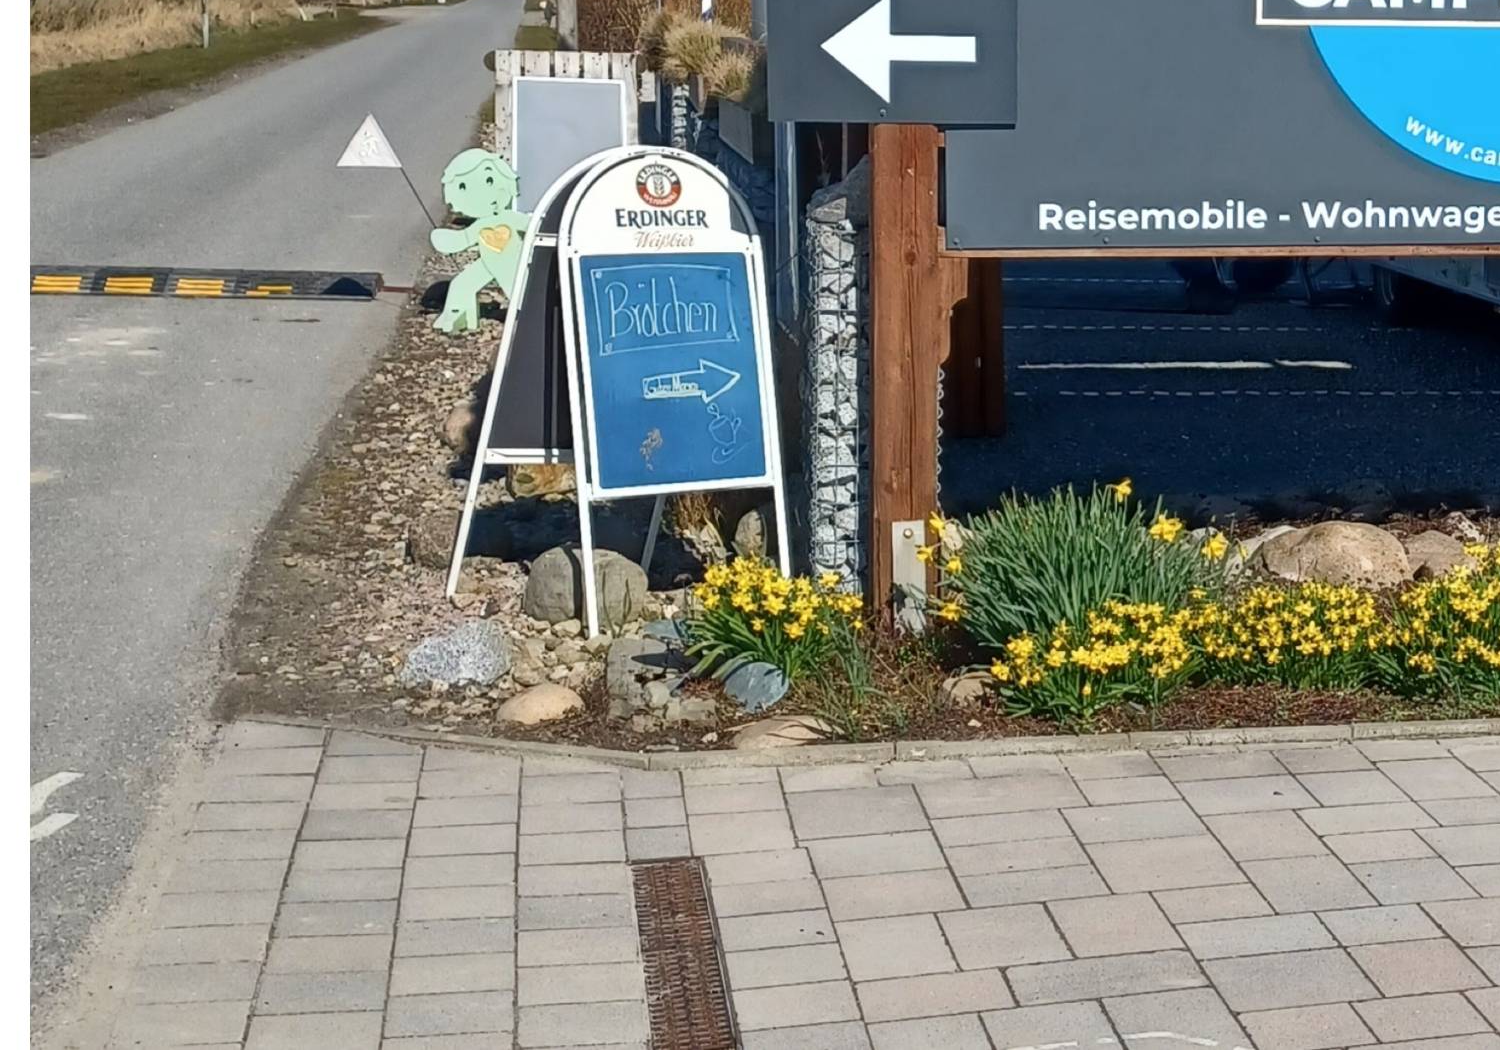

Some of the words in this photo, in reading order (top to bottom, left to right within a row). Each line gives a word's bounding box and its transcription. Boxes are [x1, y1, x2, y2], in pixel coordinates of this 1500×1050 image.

[614, 208, 710, 229] ERDINGER
[1037, 198, 1269, 232] Reisemobile
[604, 276, 718, 338] Brötchen
